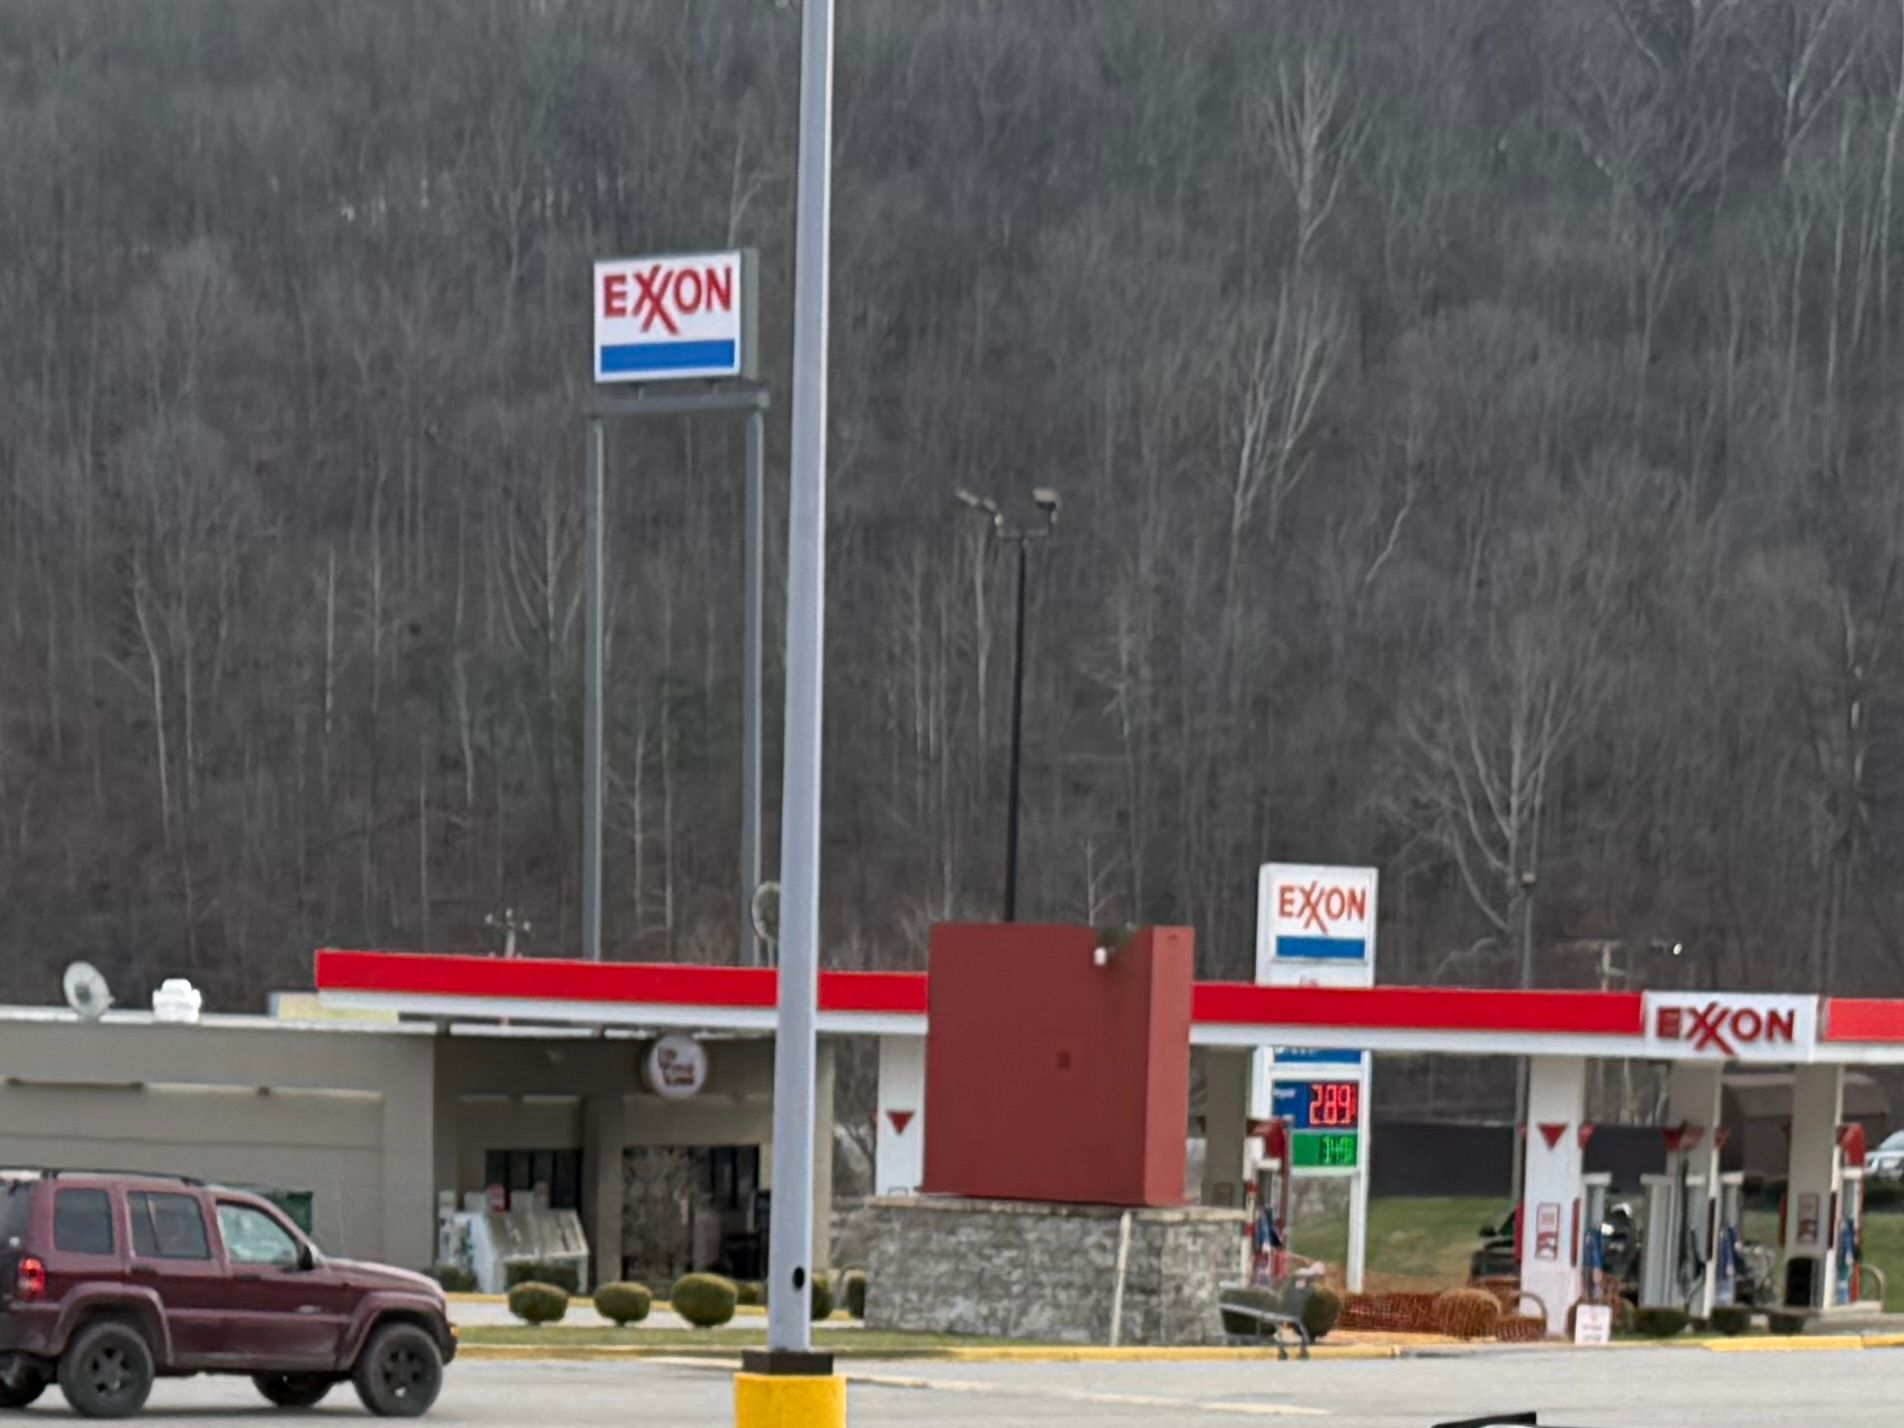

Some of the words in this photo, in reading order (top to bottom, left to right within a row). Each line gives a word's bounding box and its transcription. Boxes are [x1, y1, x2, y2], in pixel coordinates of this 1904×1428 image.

[603, 264, 734, 336] EXXON
[1279, 880, 1366, 936] EXXON
[1657, 1001, 1795, 1057] EXXON
